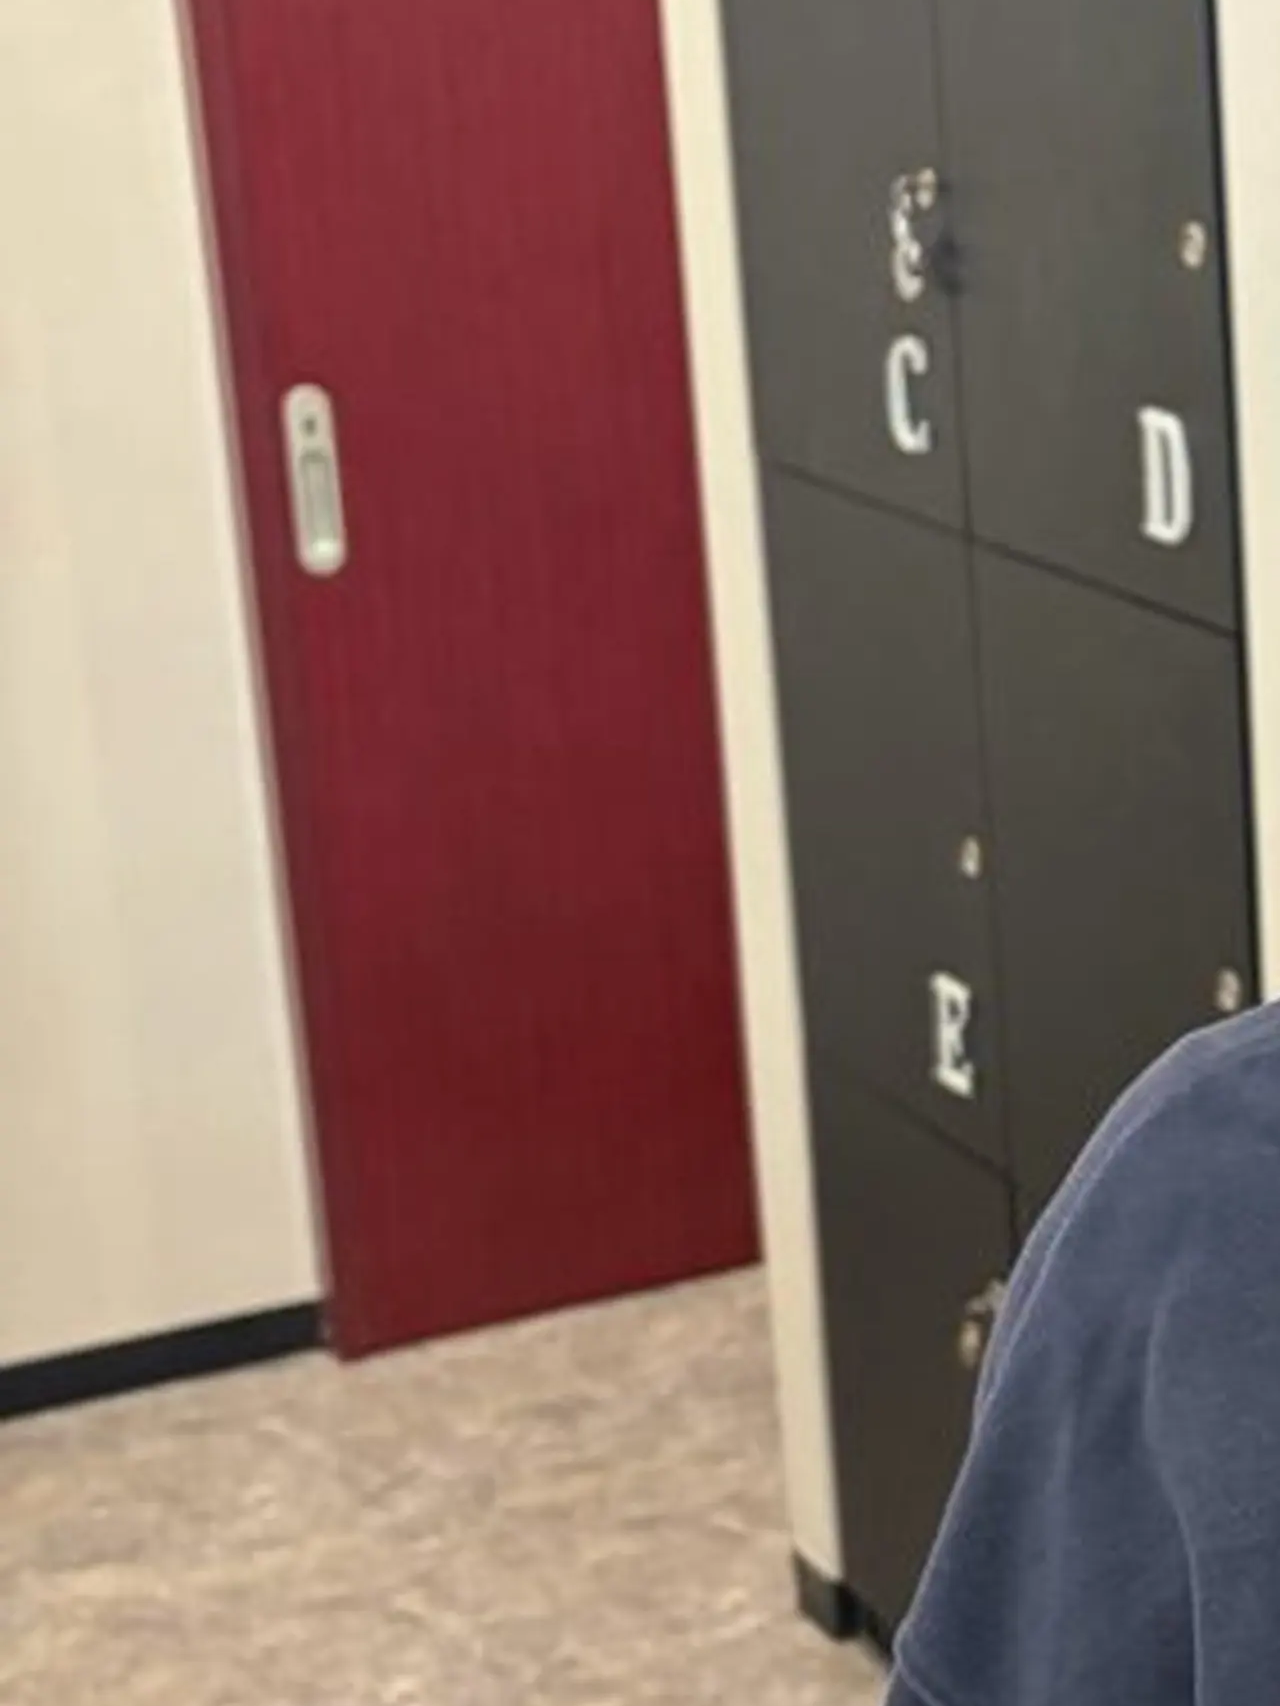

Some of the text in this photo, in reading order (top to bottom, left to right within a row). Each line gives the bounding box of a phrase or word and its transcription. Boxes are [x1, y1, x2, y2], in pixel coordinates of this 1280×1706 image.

[885, 334, 930, 455] C
[1137, 404, 1192, 546] D
[930, 969, 975, 1097] E
